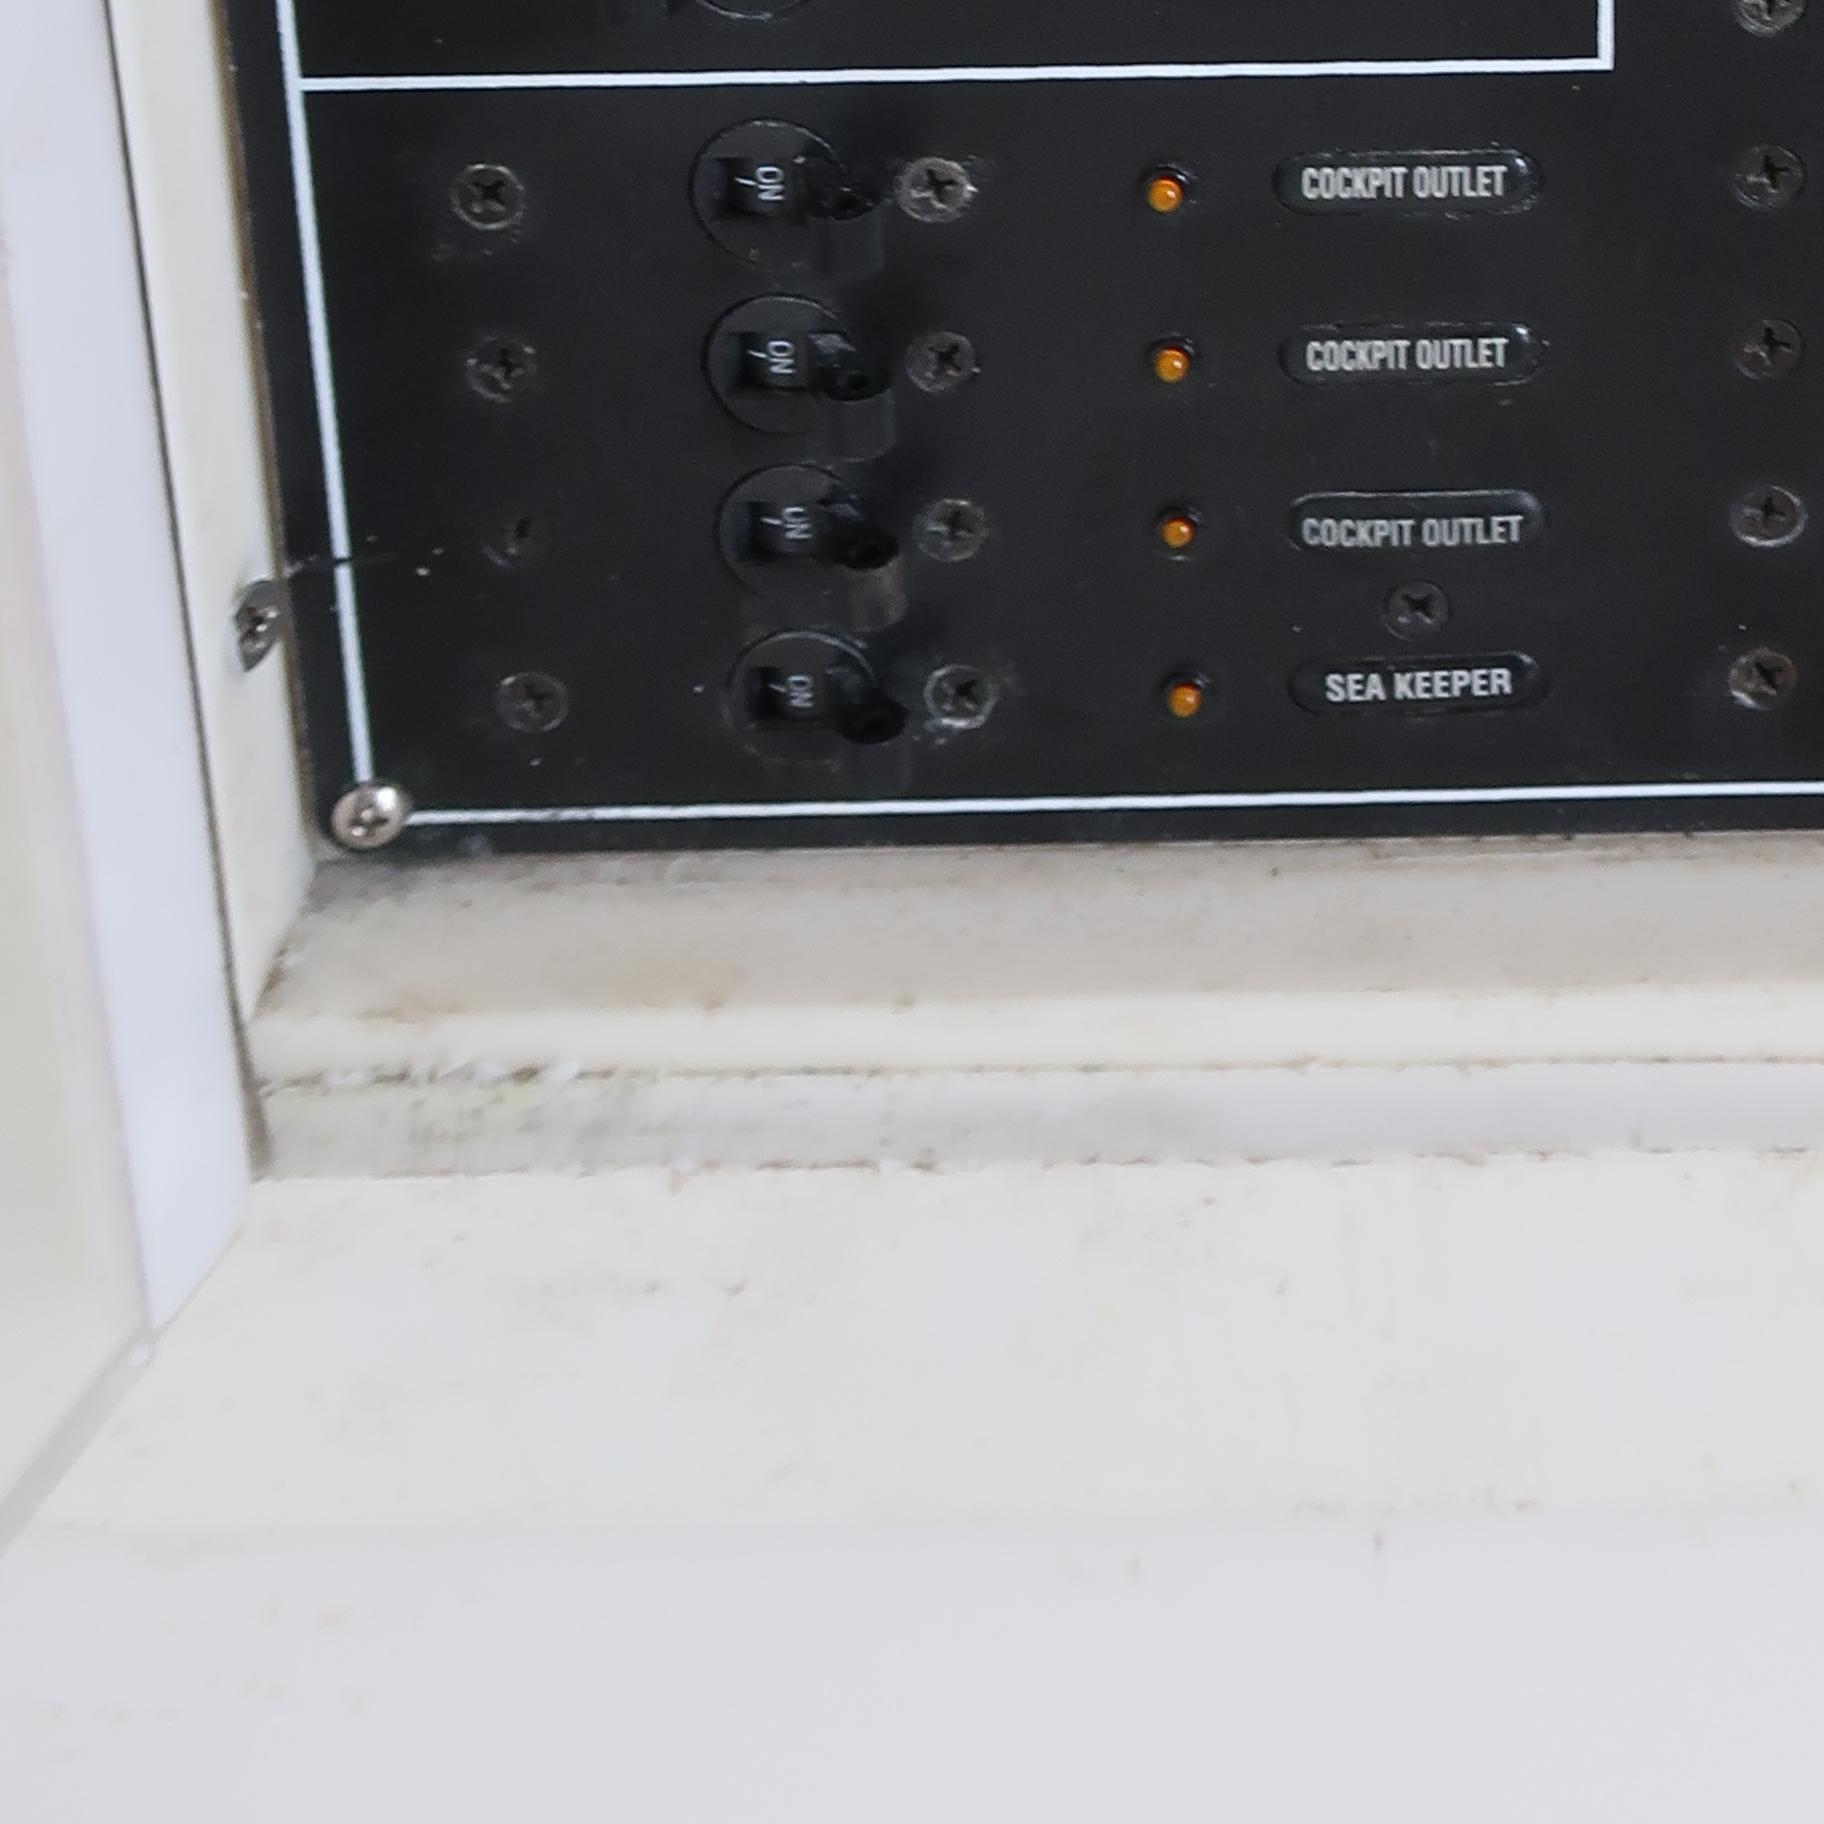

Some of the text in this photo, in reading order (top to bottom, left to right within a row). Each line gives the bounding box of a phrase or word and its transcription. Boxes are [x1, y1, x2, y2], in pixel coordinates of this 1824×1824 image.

[756, 166, 784, 200] ON
[1302, 165, 1507, 199] COCKPIT OUTLET
[767, 340, 794, 374] ON
[1307, 337, 1509, 371] COCKPIT OUTLET
[782, 506, 811, 539] ON
[1302, 515, 1524, 547] COCKPIT OUTLET
[787, 675, 812, 707] ON
[1326, 668, 1512, 702] SEA KEEPER
